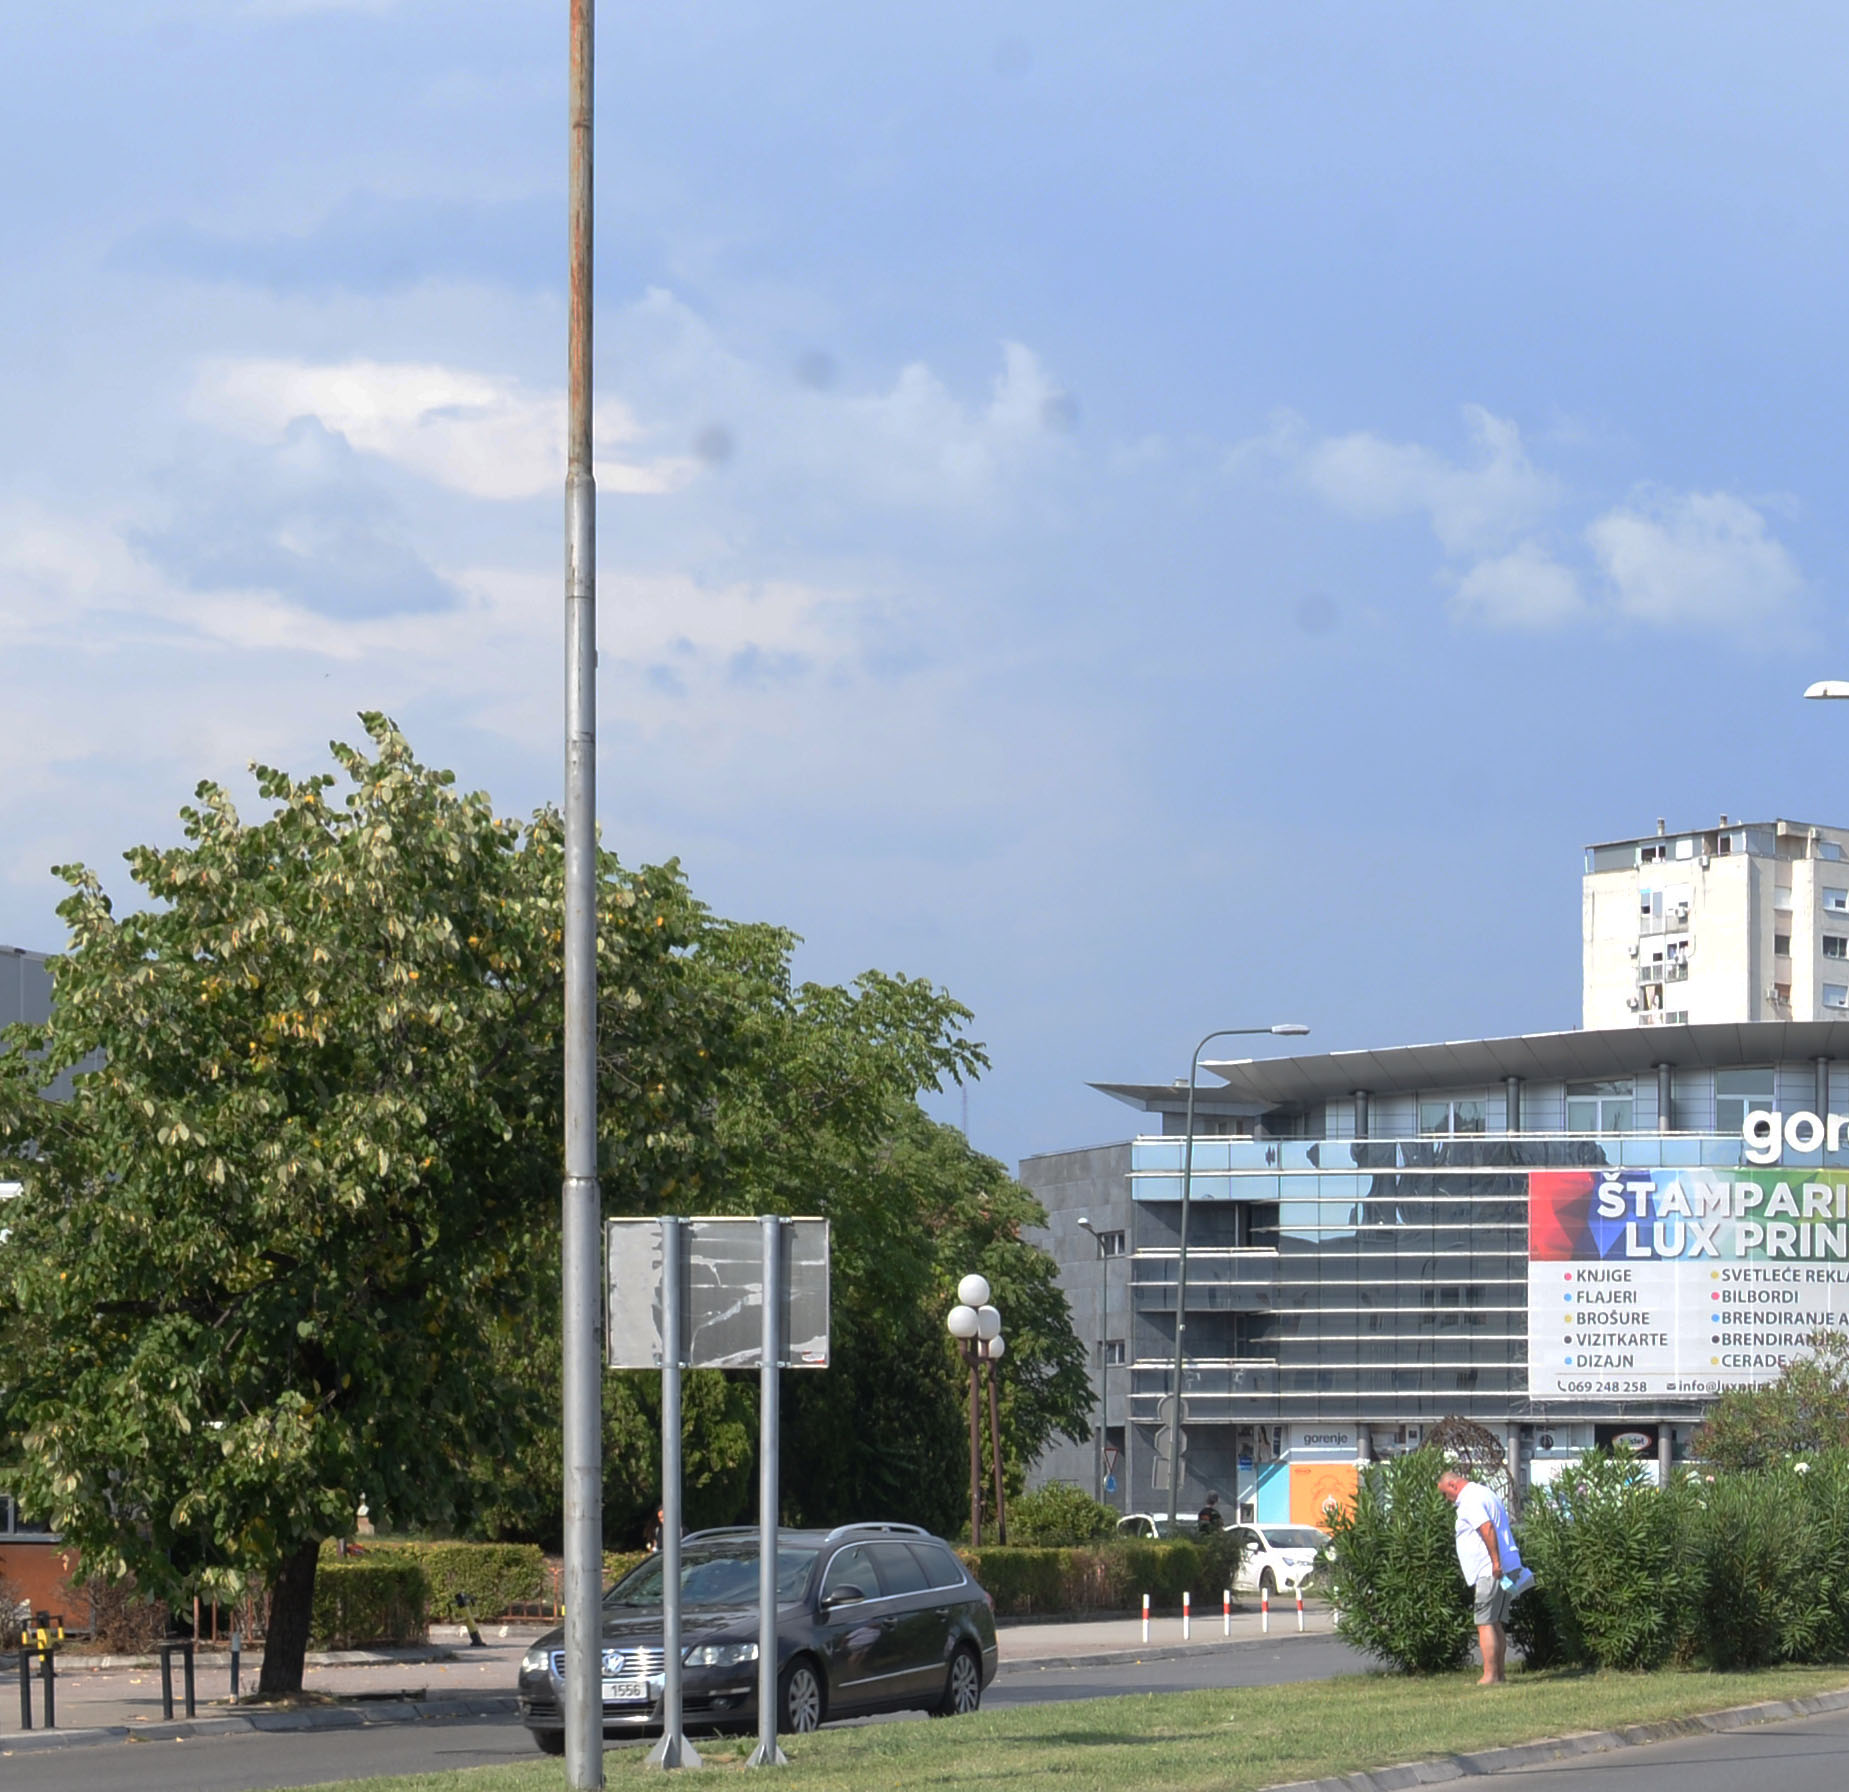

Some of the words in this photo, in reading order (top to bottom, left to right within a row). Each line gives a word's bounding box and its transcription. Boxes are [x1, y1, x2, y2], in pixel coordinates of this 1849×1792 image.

[1625, 1221, 1720, 1258] LUX
[1576, 1269, 1632, 1283] KNJIGE
[1721, 1266, 1801, 1283] SVETLEĆE
[1576, 1290, 1637, 1304] FLAJERI
[1722, 1289, 1799, 1304] BILBORDI
[1576, 1309, 1651, 1326] BROŠURE
[1722, 1311, 1834, 1326] BRENDIRANJE
[1576, 1332, 1669, 1347] VIZITKARTE
[1576, 1354, 1634, 1369] DIZAJN
[1721, 1354, 1787, 1368] CERADE
[1567, 1381, 1593, 1393] 069
[1596, 1381, 1620, 1393] 248
[1623, 1381, 1648, 1393] 258
[1303, 1432, 1349, 1445] gorenje
[610, 1684, 642, 1697] 1556
